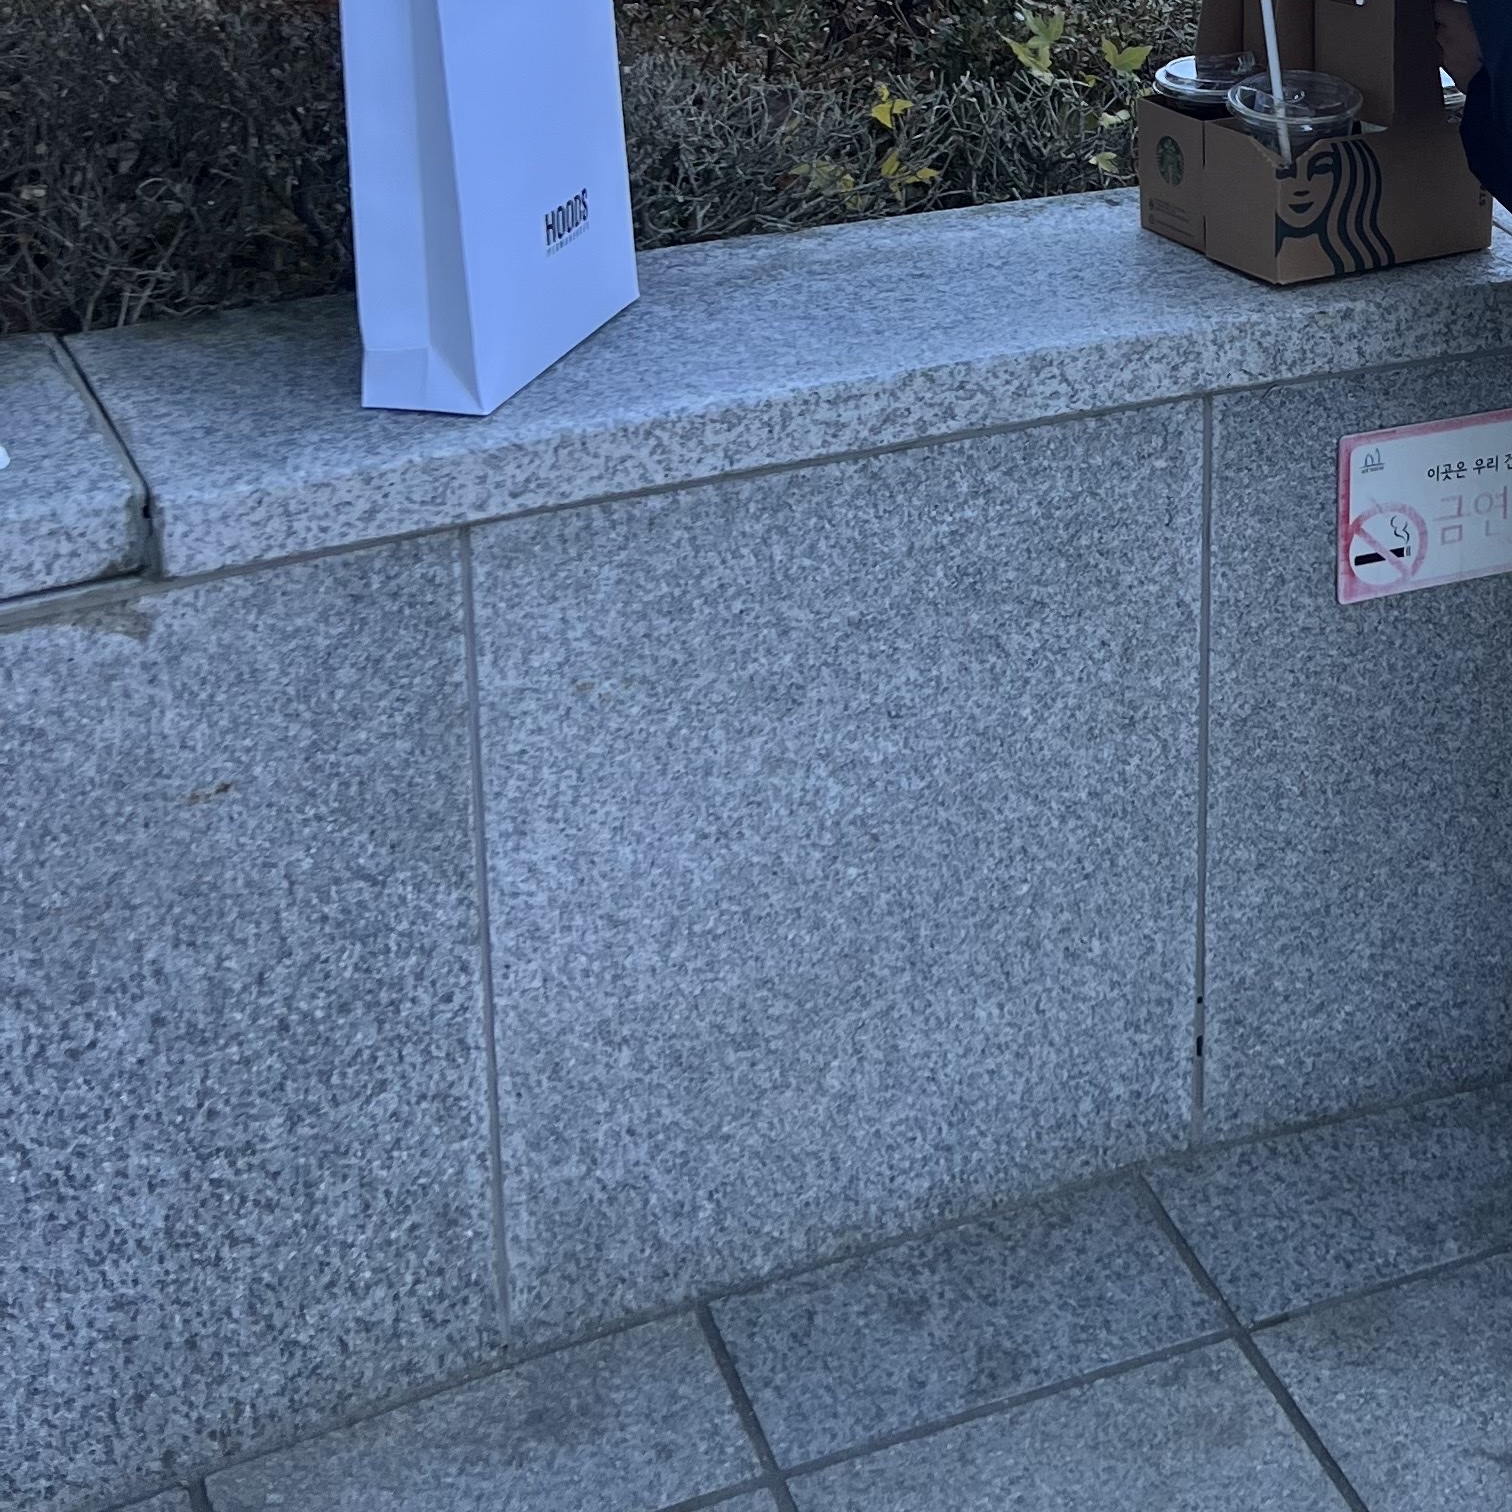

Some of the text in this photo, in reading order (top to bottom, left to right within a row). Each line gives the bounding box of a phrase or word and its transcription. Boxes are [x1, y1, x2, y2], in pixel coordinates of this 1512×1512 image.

[545, 188, 589, 246] HOODS
[1427, 460, 1468, 481] 이곳은
[1472, 455, 1500, 473] 우리
